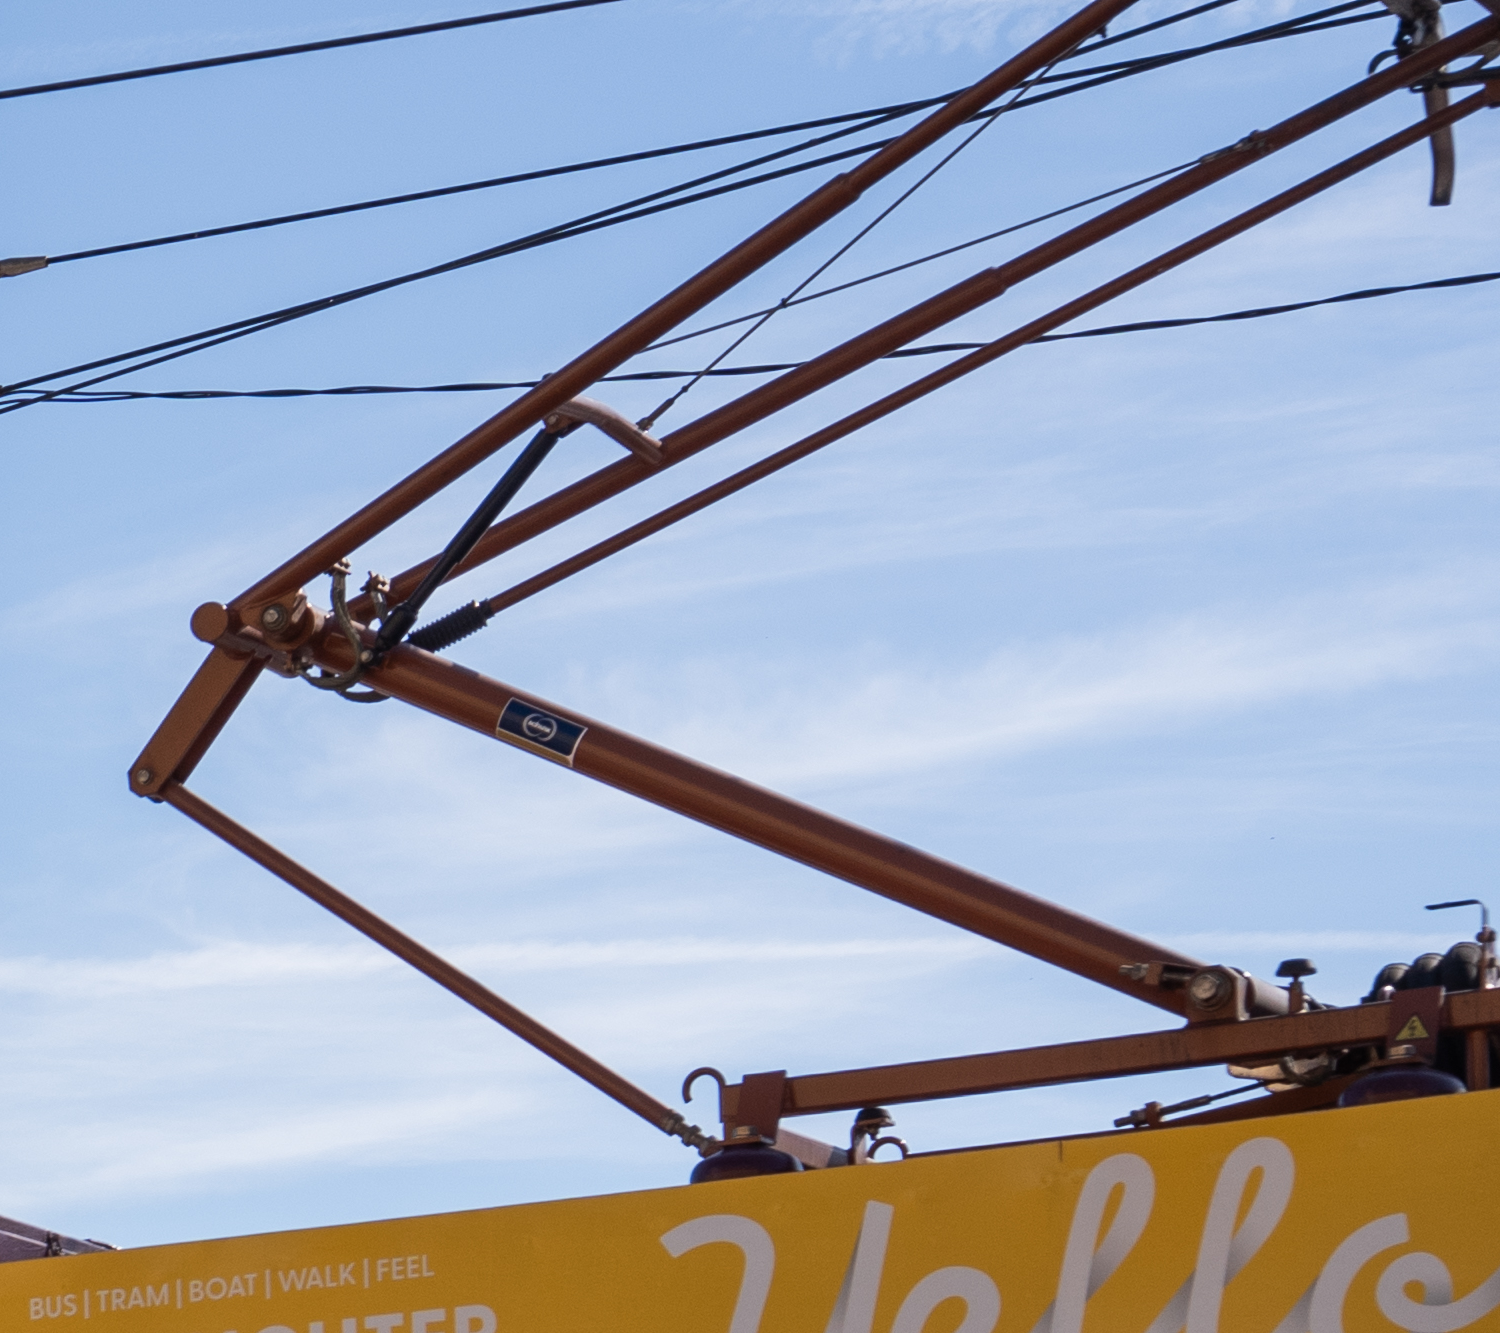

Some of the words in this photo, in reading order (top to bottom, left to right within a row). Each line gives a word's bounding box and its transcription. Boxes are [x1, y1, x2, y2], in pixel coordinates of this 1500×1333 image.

[29, 1293, 77, 1320] BUS
[97, 1283, 169, 1312] TRAM
[189, 1273, 257, 1302] BOAT
[278, 1262, 356, 1293] WALK
[376, 1254, 434, 1281] FEEL
